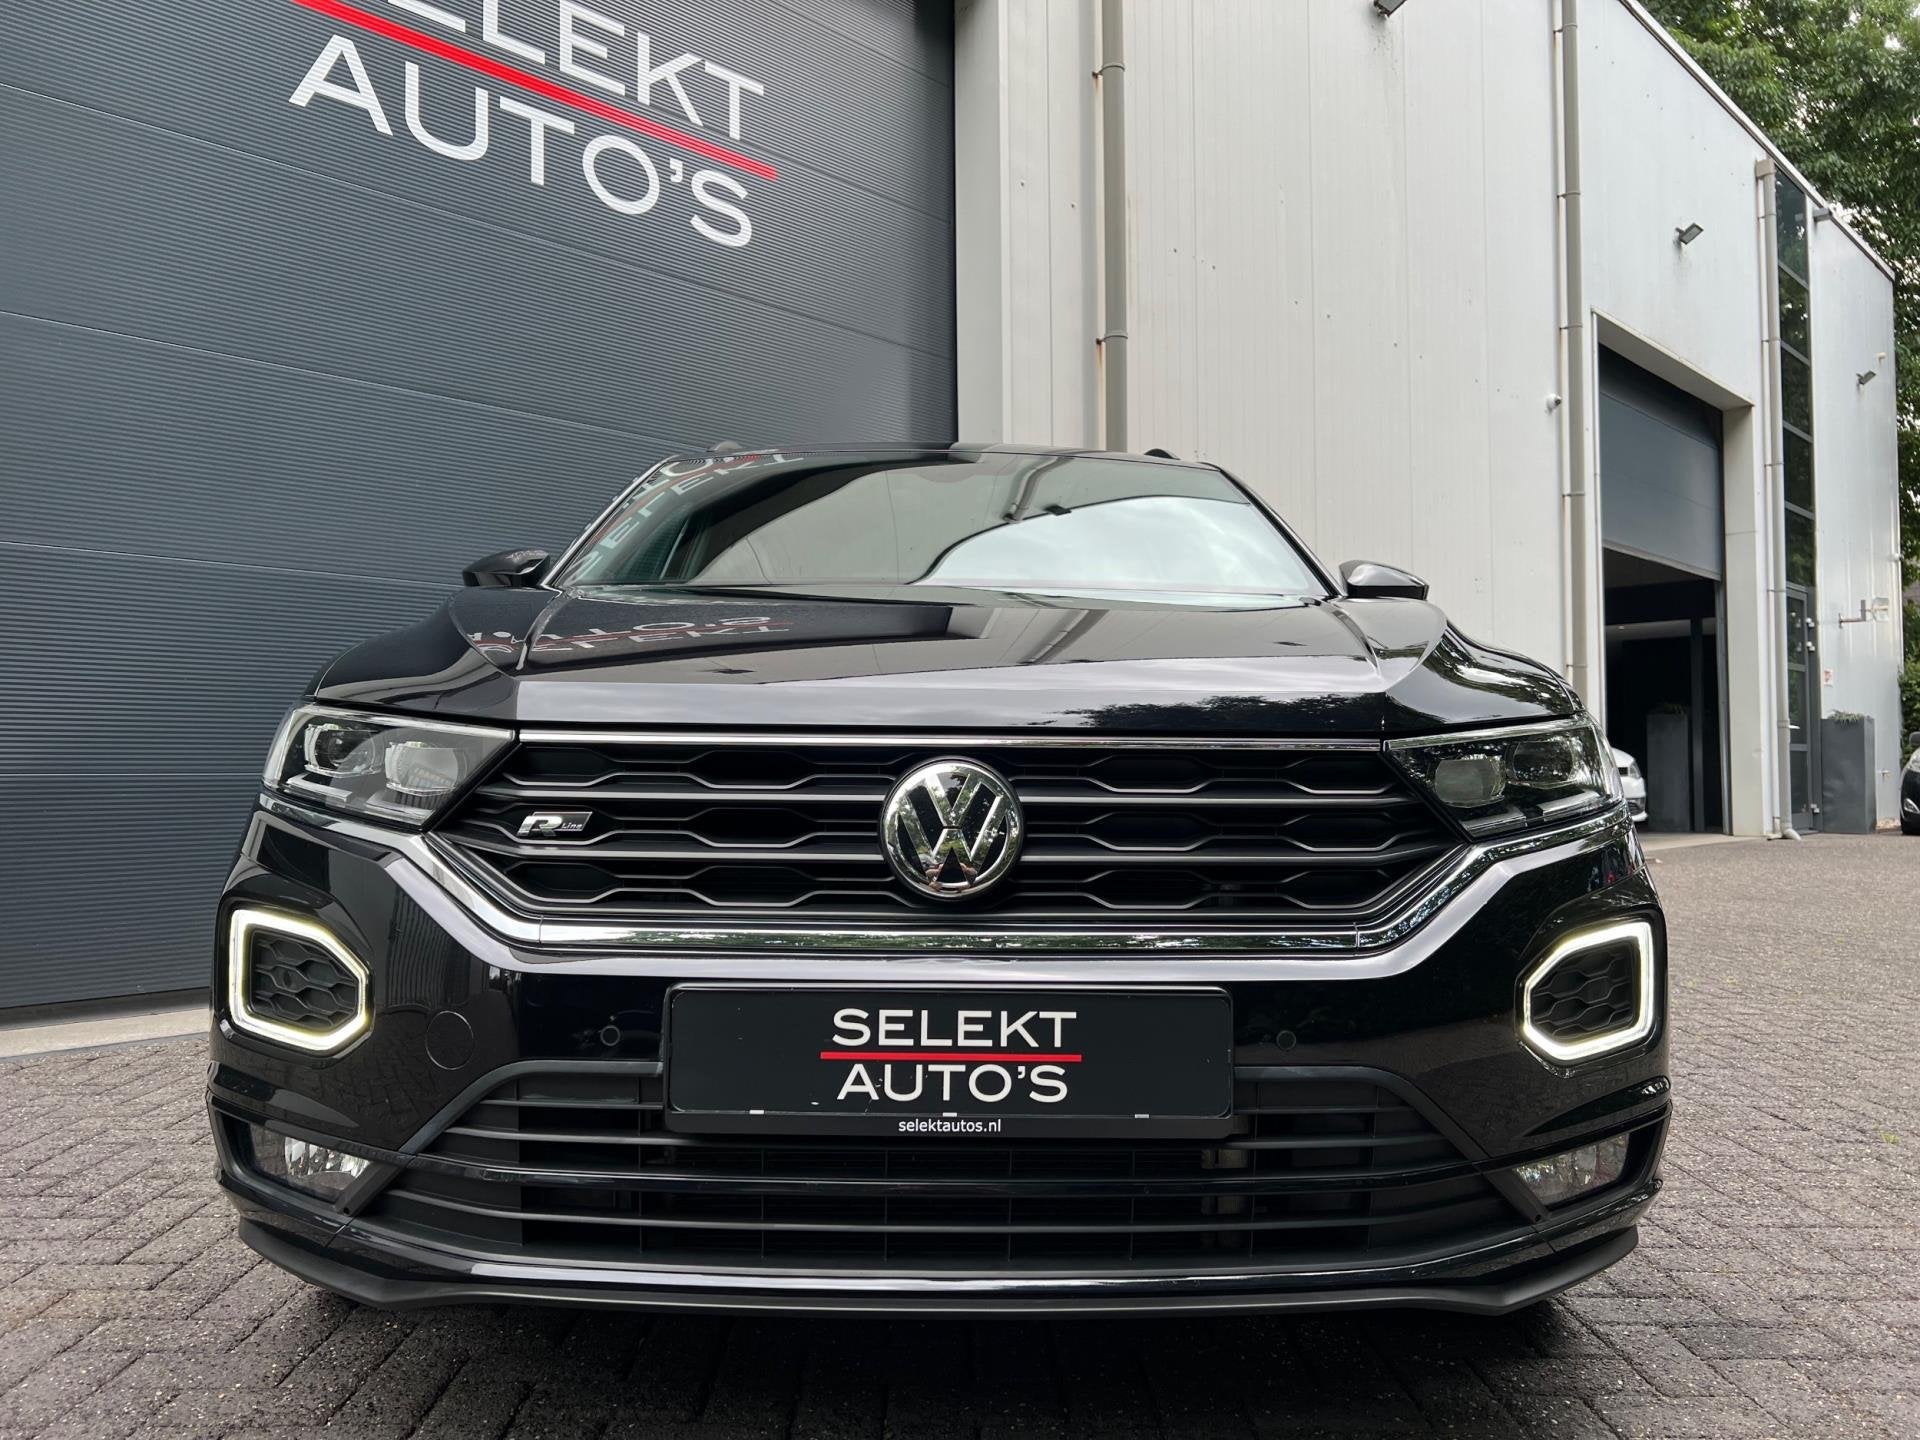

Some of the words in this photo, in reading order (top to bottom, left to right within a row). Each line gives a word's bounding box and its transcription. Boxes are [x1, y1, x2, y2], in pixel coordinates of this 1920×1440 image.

[387, 0, 764, 140] LEKT
[288, 34, 752, 247] AUTO'S
[832, 1008, 1077, 1048] SELEKT
[837, 1063, 1068, 1103] AUTO'S
[898, 1118, 1001, 1132] selektautos.nl
